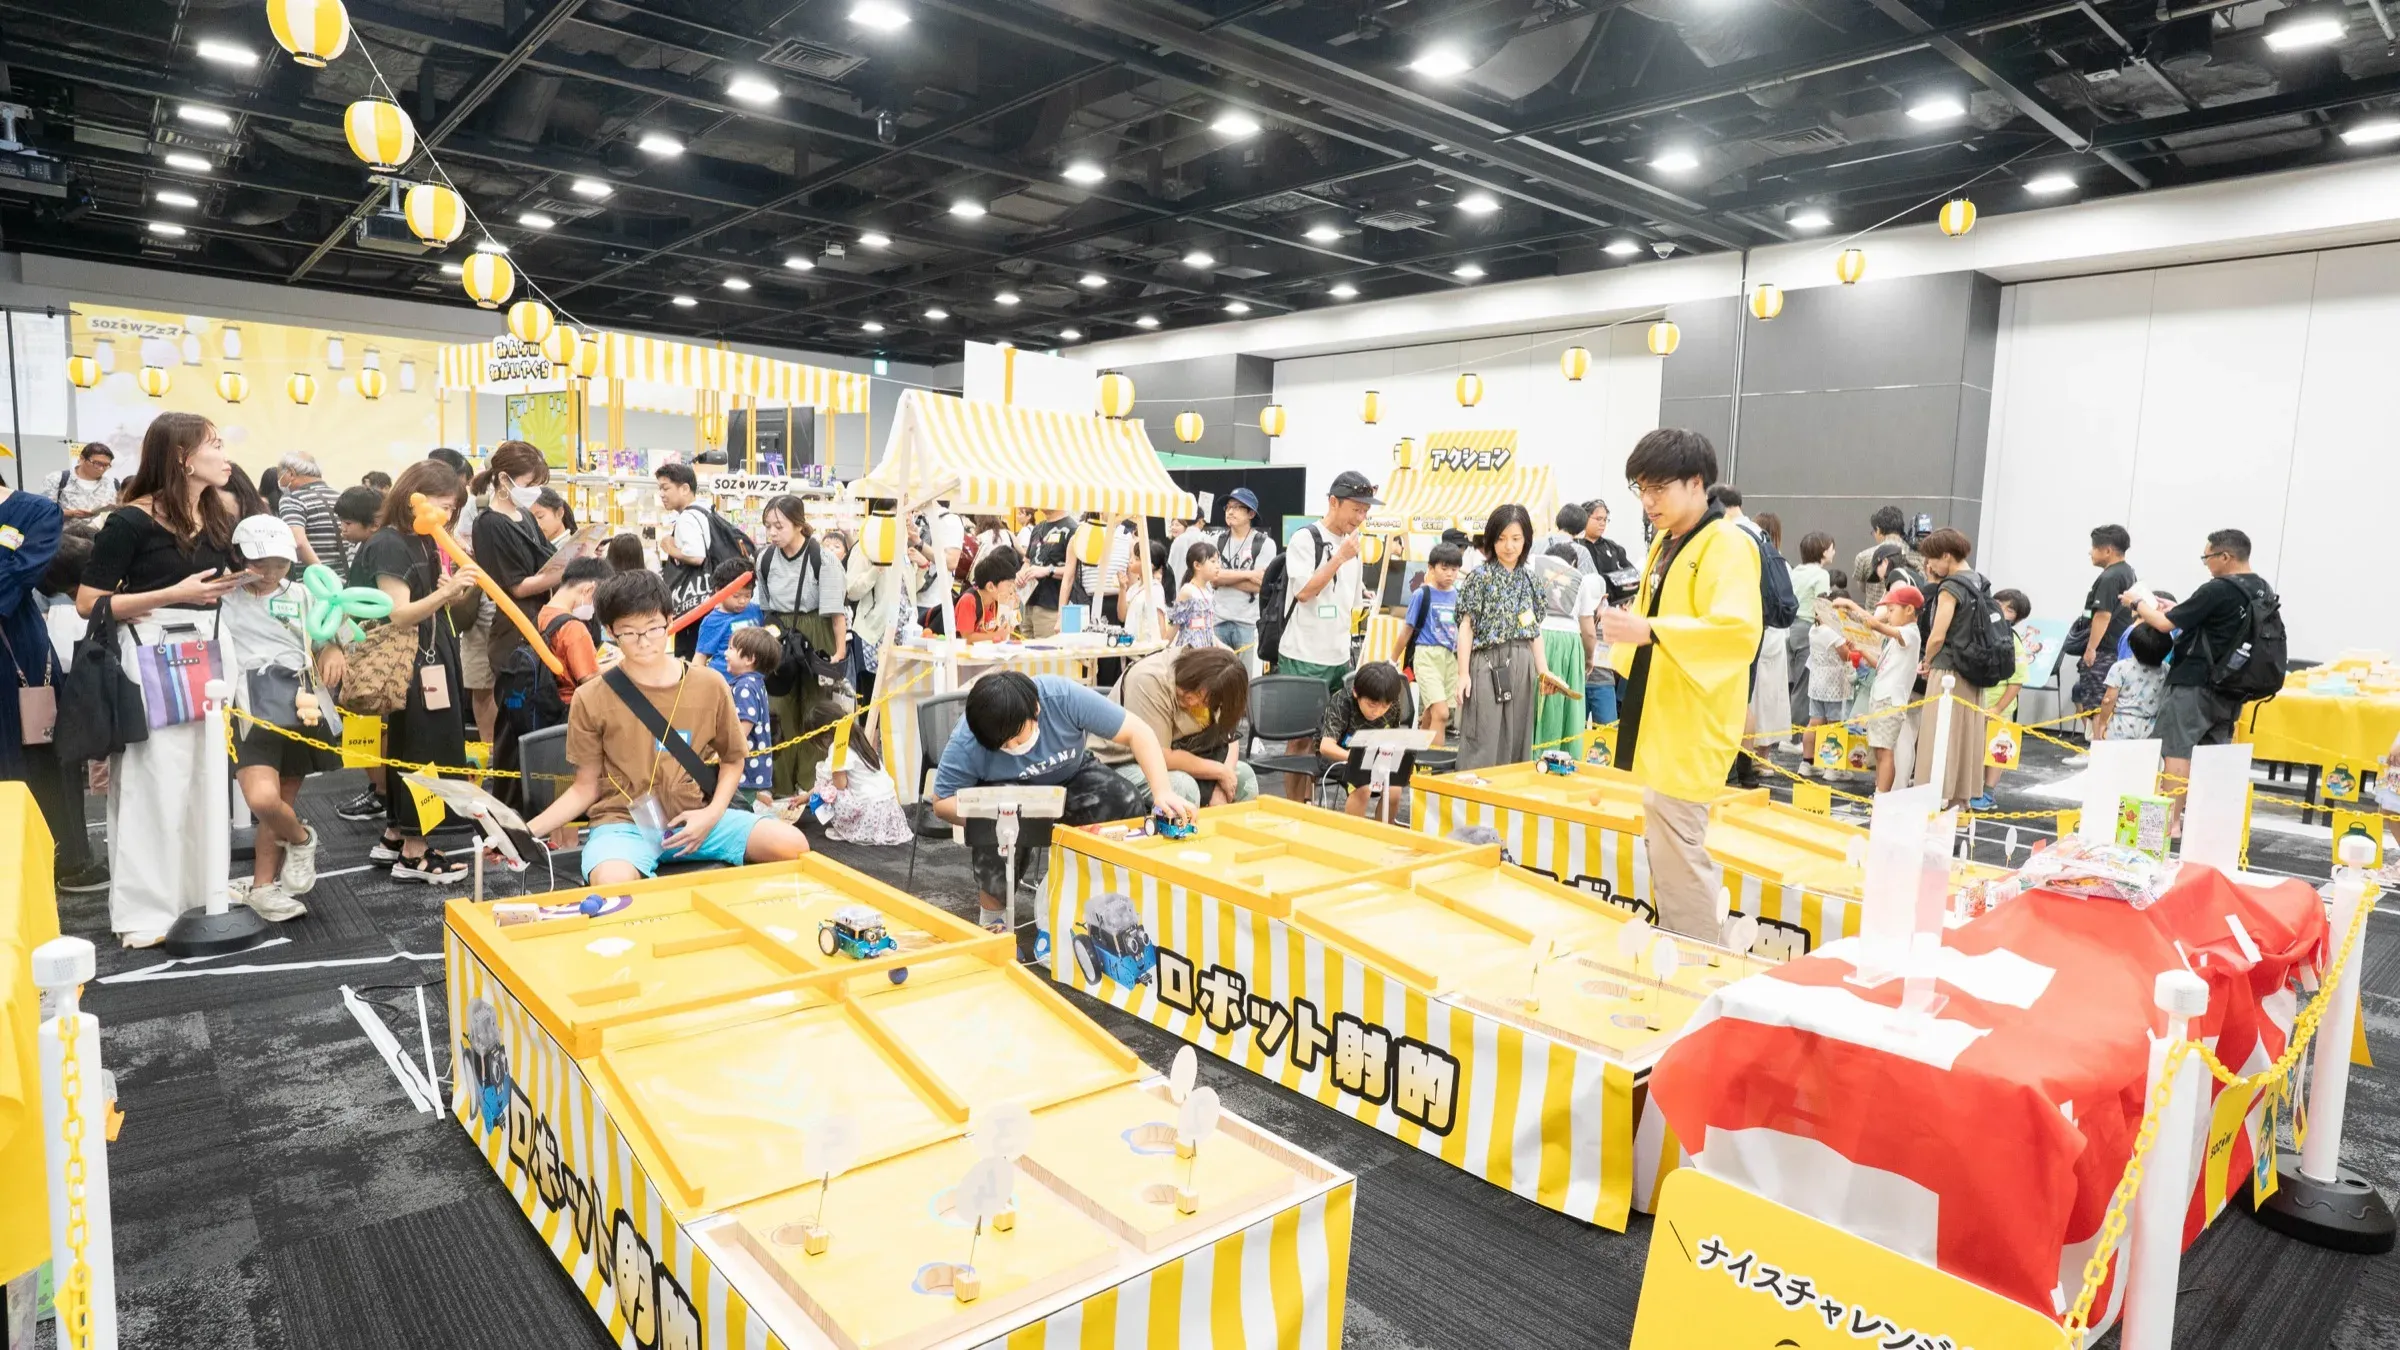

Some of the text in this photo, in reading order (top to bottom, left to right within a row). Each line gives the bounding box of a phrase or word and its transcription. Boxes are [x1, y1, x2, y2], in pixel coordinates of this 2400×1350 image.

[1430, 446, 1511, 472] アクション
[1155, 945, 1460, 1137] ロボット射的
